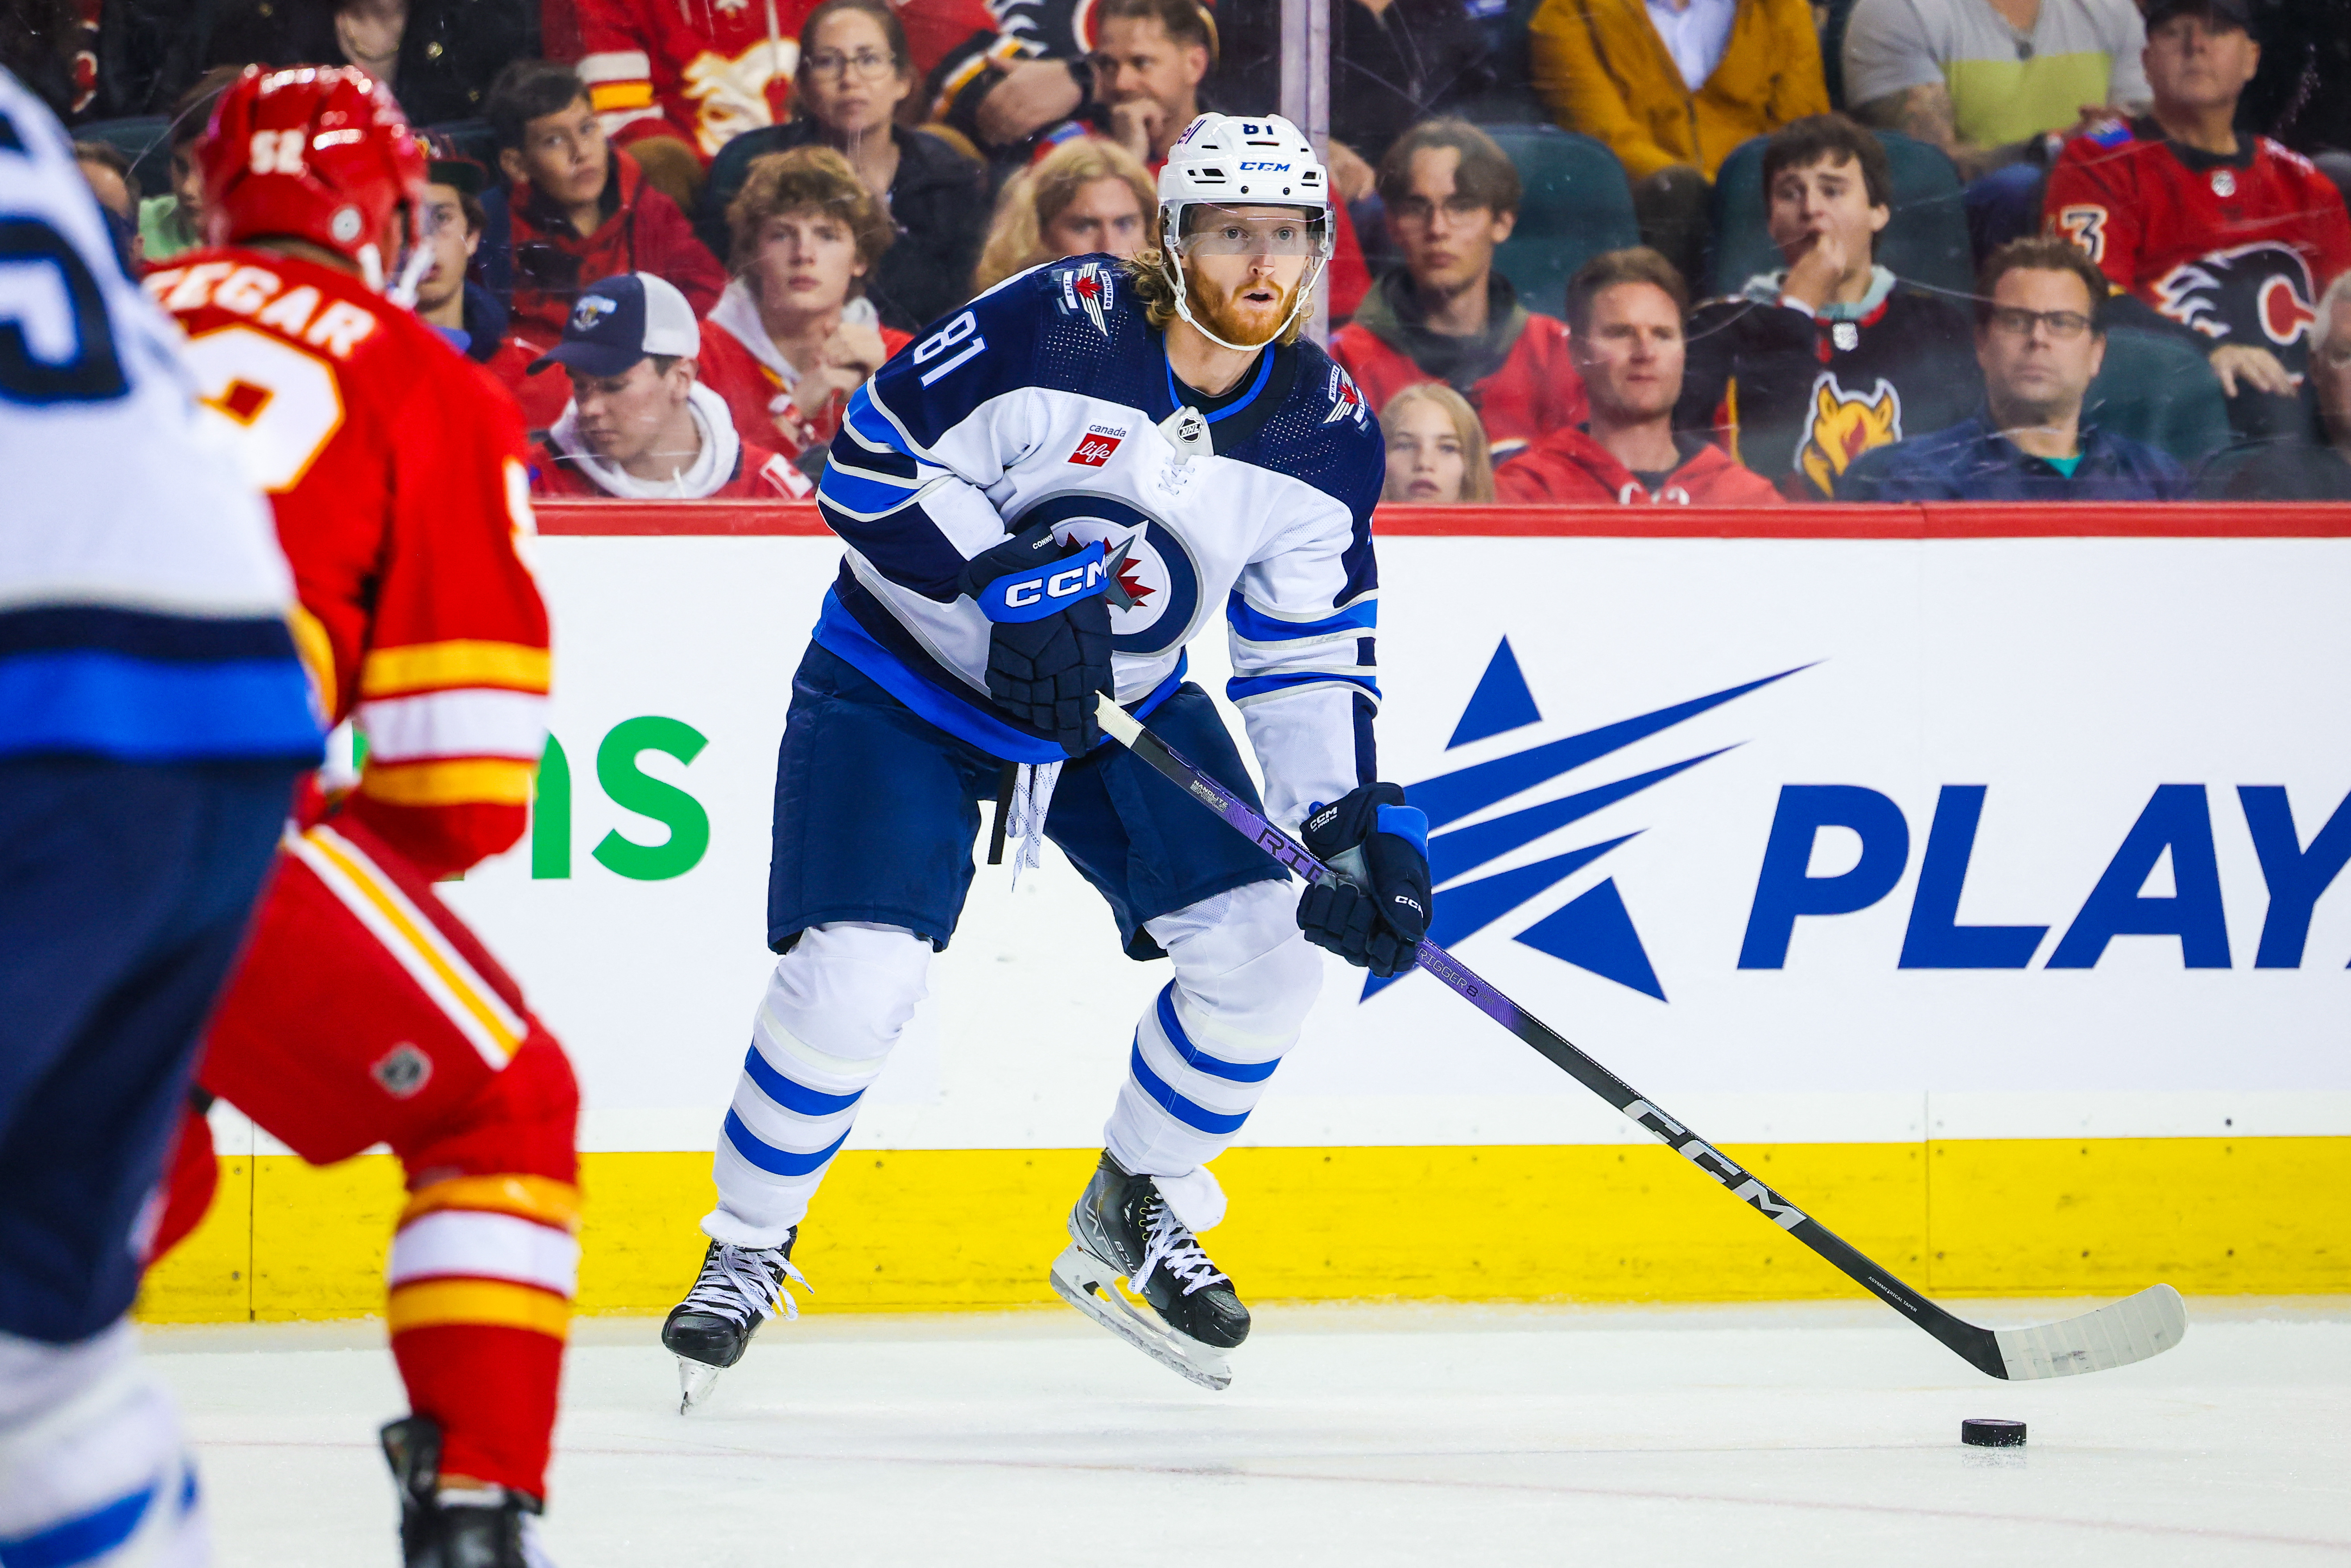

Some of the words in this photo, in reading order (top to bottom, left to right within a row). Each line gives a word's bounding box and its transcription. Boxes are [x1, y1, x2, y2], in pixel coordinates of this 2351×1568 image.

[1240, 161, 1291, 172] CCM
[1102, 273, 1112, 307] WINNIPEG
[912, 309, 988, 390] 81
[1089, 425, 1127, 437] canada
[1181, 424, 1202, 436] NHL
[1075, 441, 1110, 463] life
[1005, 554, 1107, 608] CCM
[1310, 806, 1338, 830] CCM
[1417, 948, 1467, 989] RIGGER
[1466, 985, 1478, 998] 8
[1622, 1098, 1807, 1231] CCM
[1868, 1276, 1903, 1303] ASYMMETRICAL
[1903, 1300, 1917, 1312] TAPER
